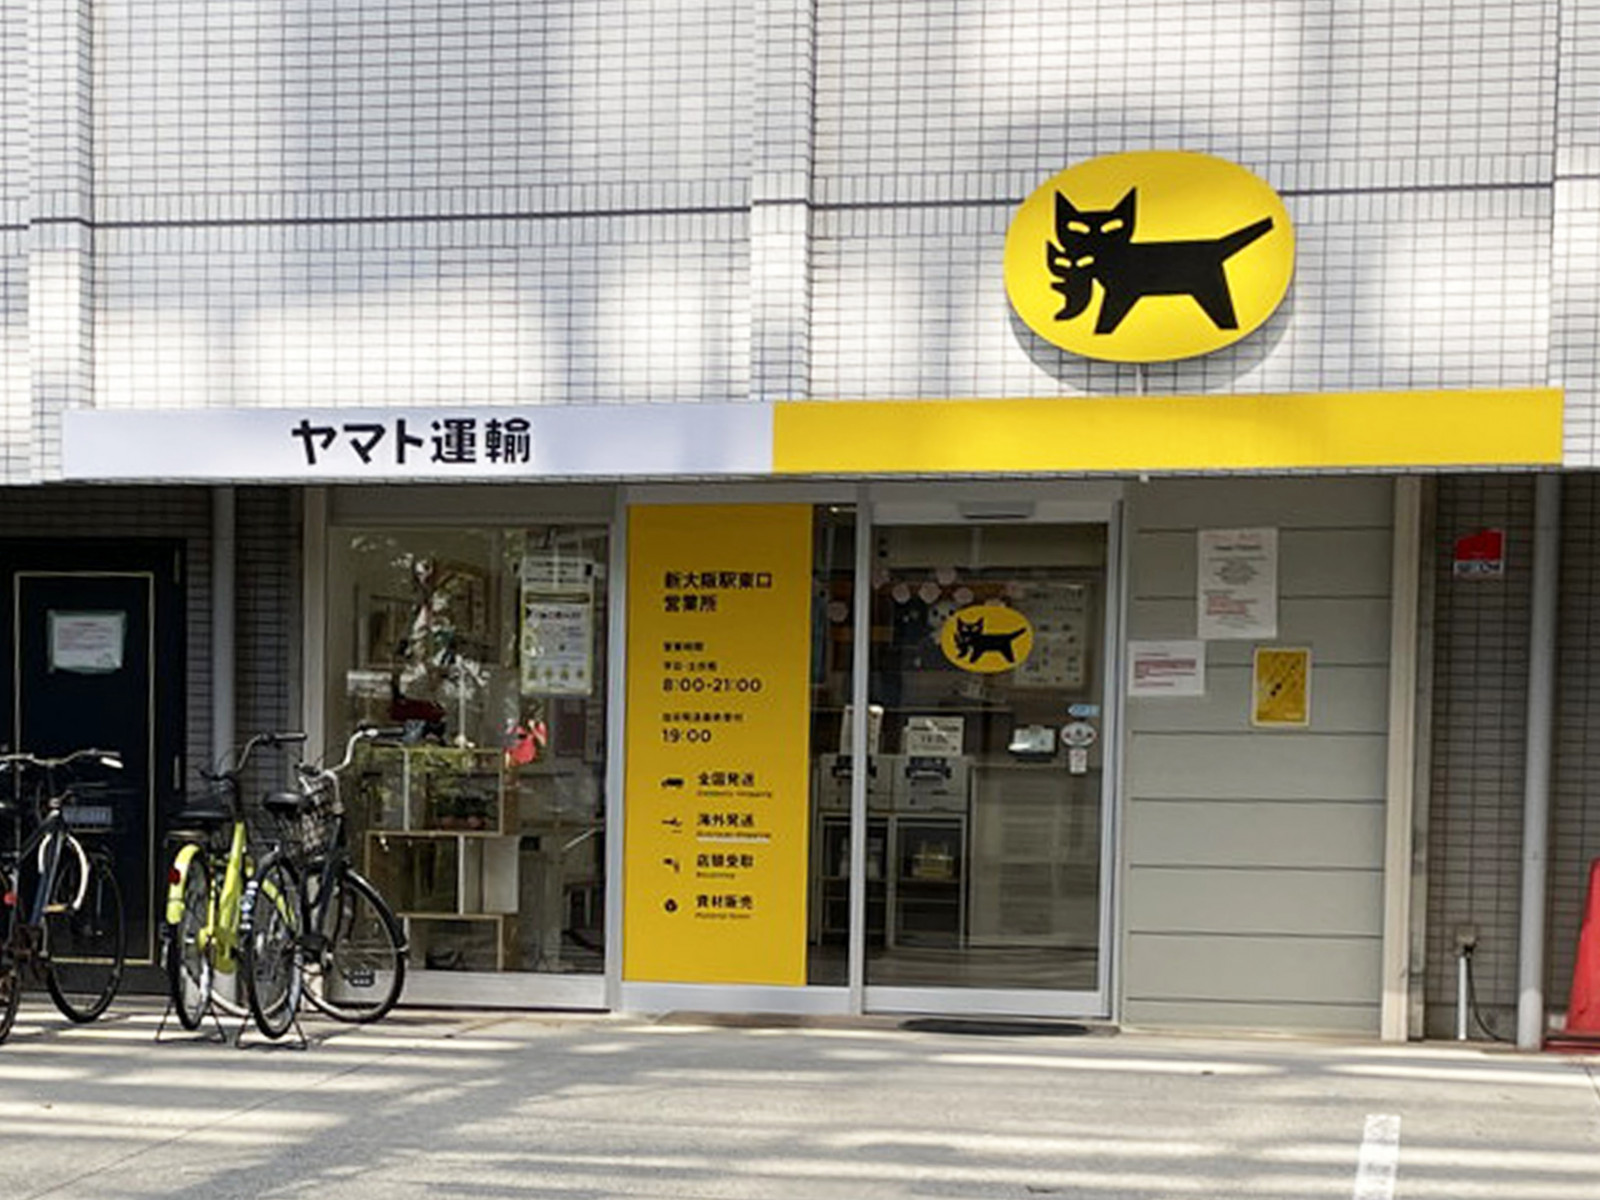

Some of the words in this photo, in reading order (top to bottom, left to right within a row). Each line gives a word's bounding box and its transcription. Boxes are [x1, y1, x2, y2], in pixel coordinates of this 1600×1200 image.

[291, 418, 532, 465] ヤマト運輸
[662, 727, 712, 743] 19:00
[697, 771, 755, 788] 全国発送
[697, 812, 755, 828] 海外発送
